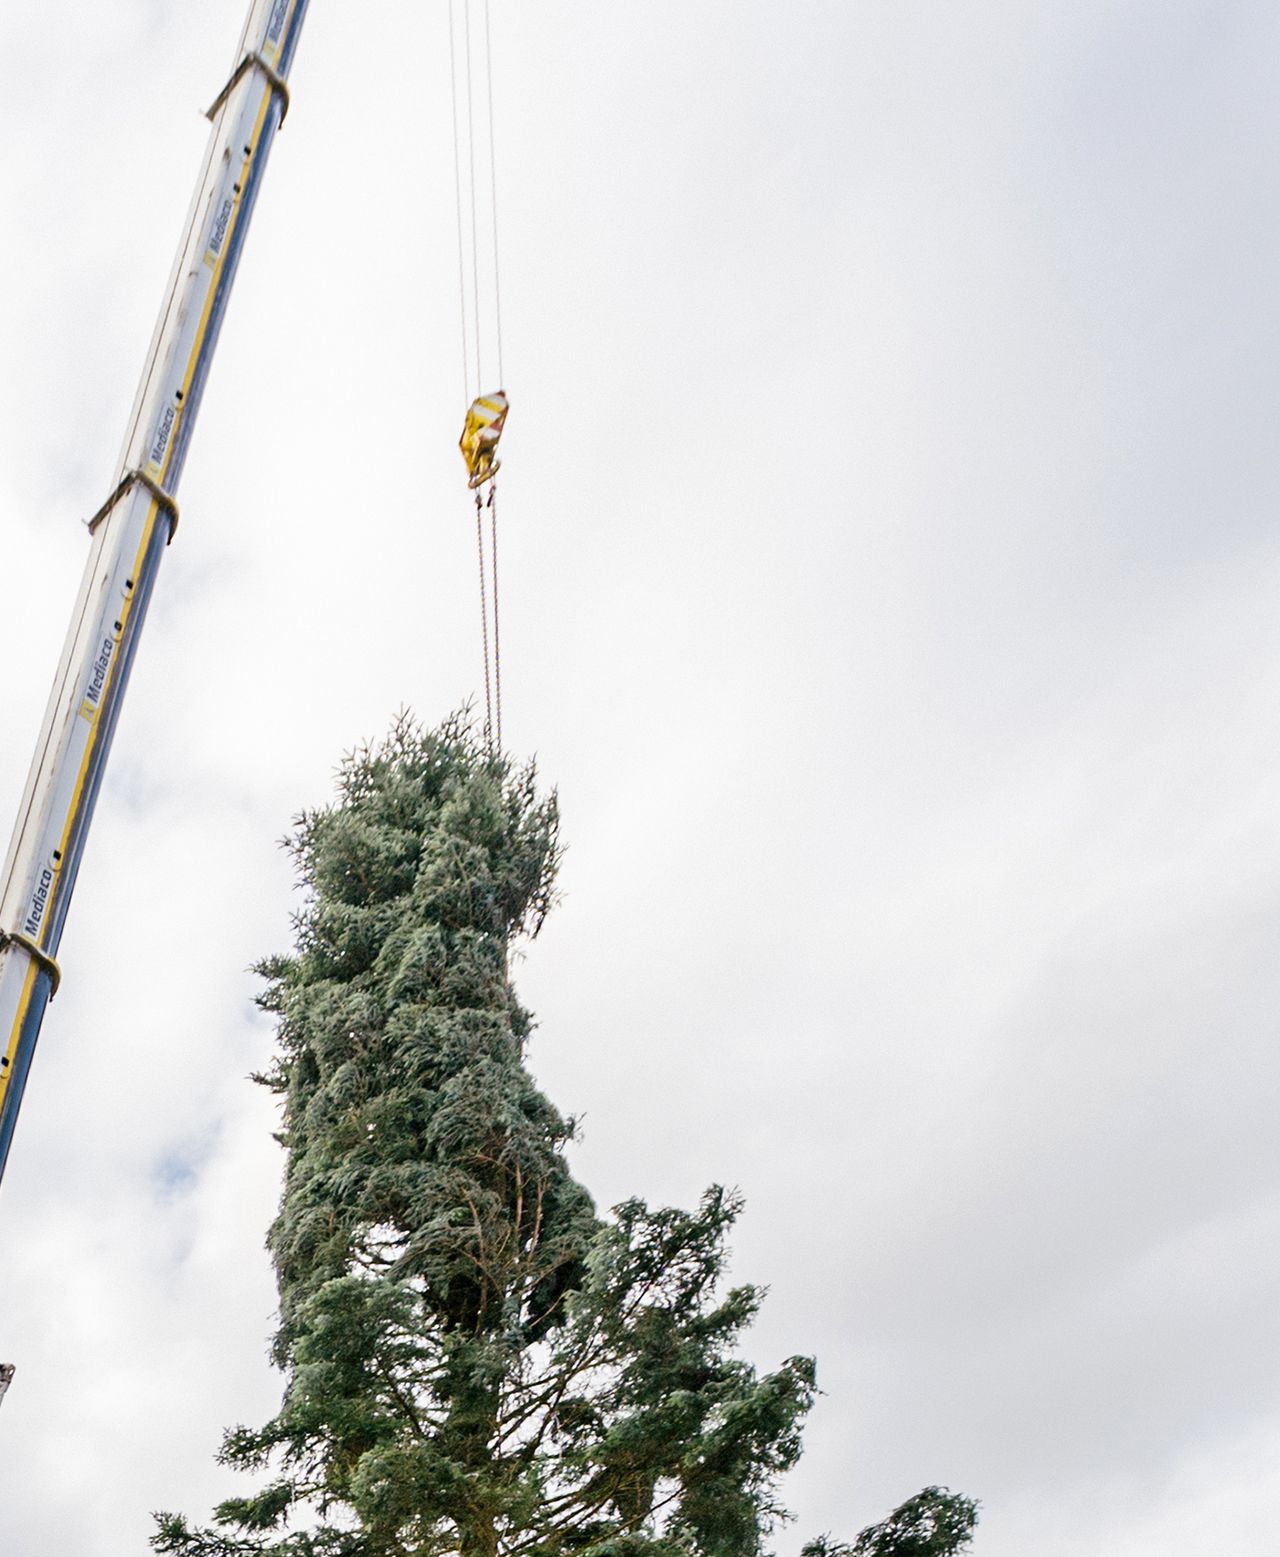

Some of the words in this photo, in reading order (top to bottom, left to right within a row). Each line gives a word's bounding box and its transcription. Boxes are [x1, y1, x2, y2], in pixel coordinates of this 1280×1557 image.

[151, 407, 175, 465] Mediaco
[86, 638, 114, 703] Mediaco
[25, 869, 52, 937] Mediaco
